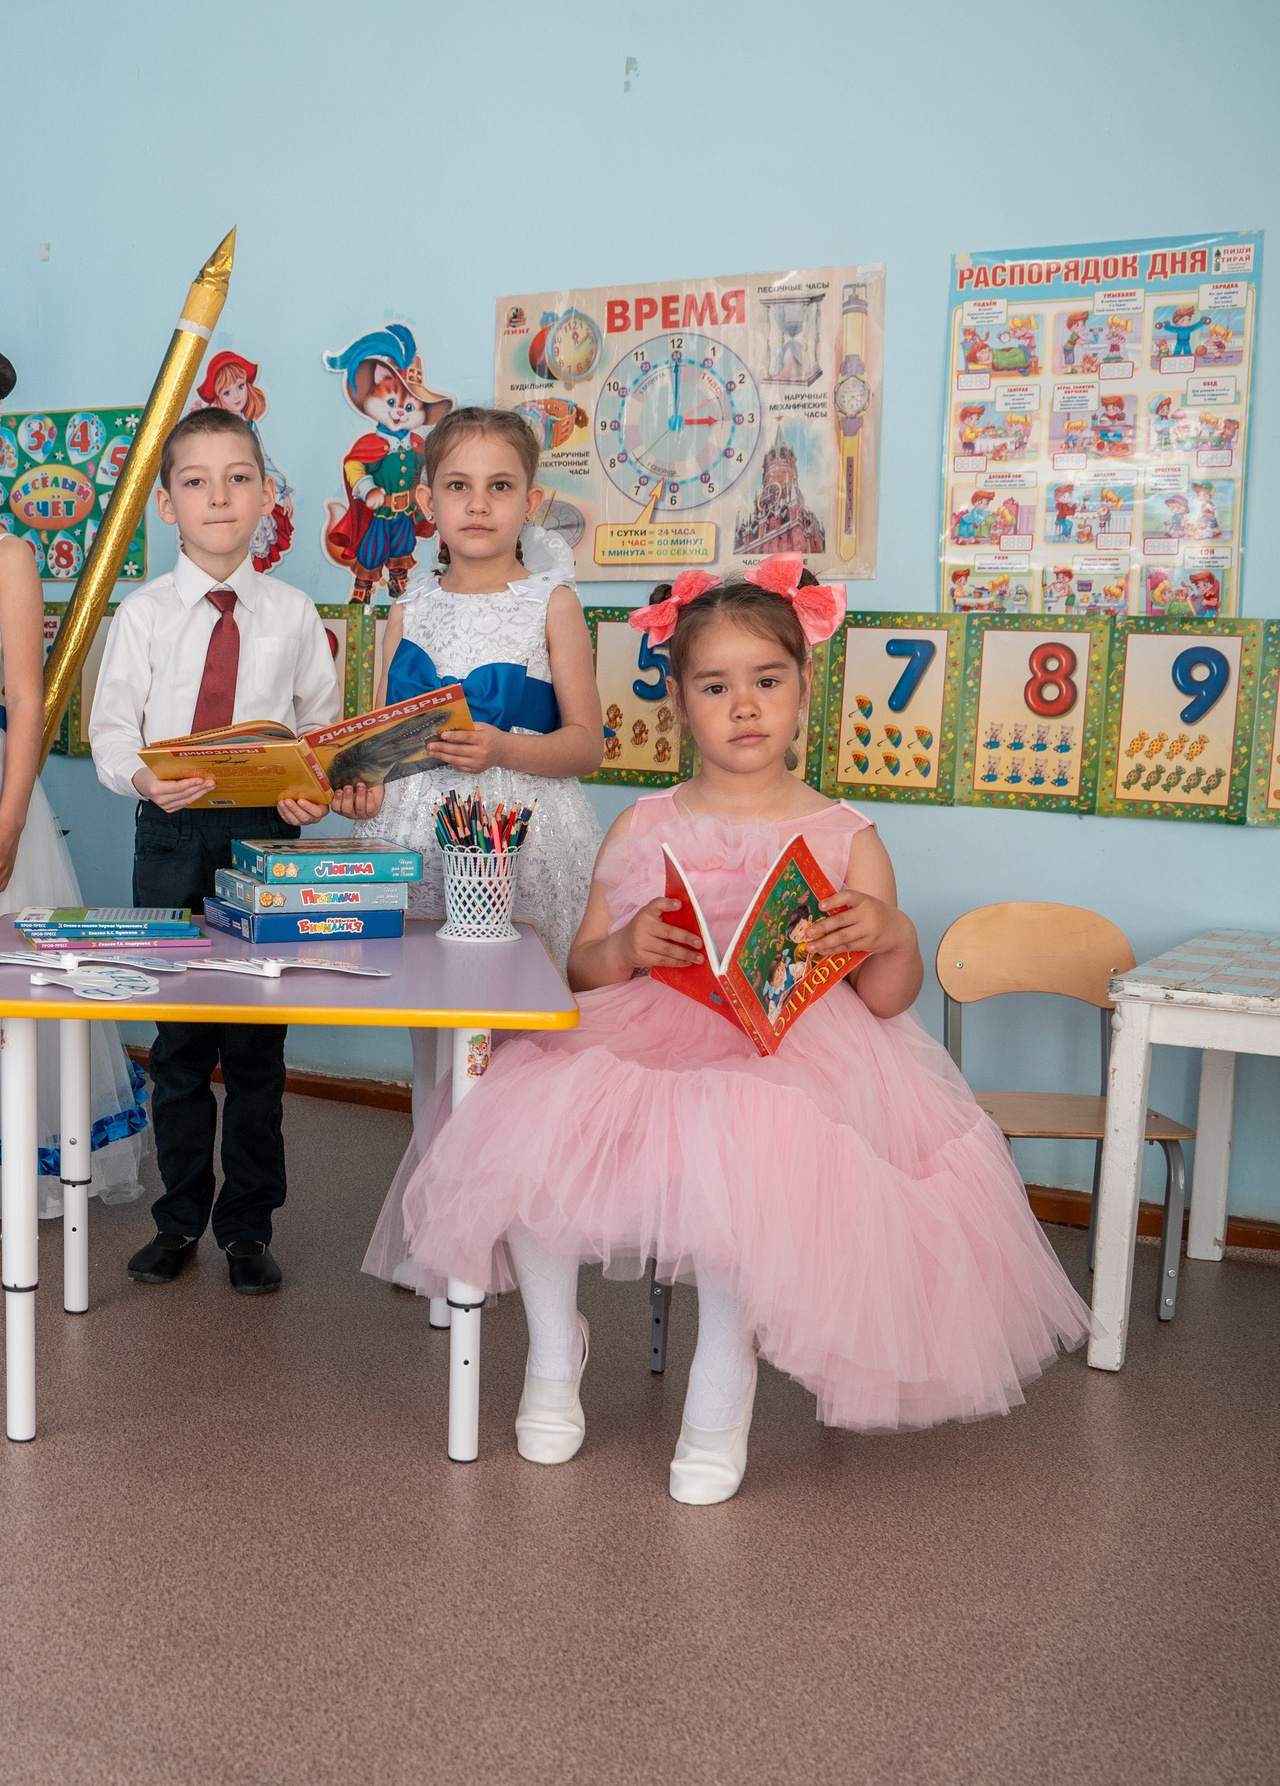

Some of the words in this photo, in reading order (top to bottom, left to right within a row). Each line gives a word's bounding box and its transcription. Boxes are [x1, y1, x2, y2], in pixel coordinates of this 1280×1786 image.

[958, 254, 1138, 289] РАСПОРЯДОК
[1148, 250, 1207, 280] ДНЯ
[758, 284, 802, 294] ПЕСОЧНЫЕ
[806, 282, 830, 290] ЧАСЫ
[606, 290, 746, 333] ВРЕМЯ
[504, 328, 530, 336] ЛИНГ
[670, 338, 683, 349] 12
[711, 347, 716, 356] 1
[634, 352, 645, 362] 11
[738, 374, 746, 384] 2
[510, 382, 554, 392] БУДИЛЬНИК
[607, 382, 619, 392] 10
[784, 392, 828, 401] НАРУЧНЫЕ
[769, 402, 828, 410] МЕХАНИЧЕСКИЕ
[748, 413, 755, 424] 3
[600, 420, 607, 431] 9
[27, 420, 46, 451] 3
[70, 420, 91, 453] 4
[110, 446, 130, 477] 5
[610, 458, 616, 468] 8
[736, 453, 743, 463] 4
[539, 460, 588, 468] ЛЕКТРОННЫЕ
[12, 472, 93, 504] ВЕСЁЛЫЙ
[634, 486, 641, 496] 7
[708, 483, 714, 493] 5
[670, 496, 677, 506] 6
[23, 495, 76, 518] СЧЁТ
[658, 528, 669, 536] 24
[670, 538, 704, 546] МИНУТ
[54, 540, 74, 569] 8
[670, 548, 708, 556] СЕКУНД
[632, 631, 671, 701] 5
[885, 639, 936, 713] 7
[1025, 643, 1077, 717] 8
[1171, 646, 1230, 724] 9
[318, 692, 452, 744] ДИНОЗАВРЫ
[179, 748, 260, 758] ДИНОЗАВРЫ
[774, 952, 852, 1037] ӘЛИФБ
